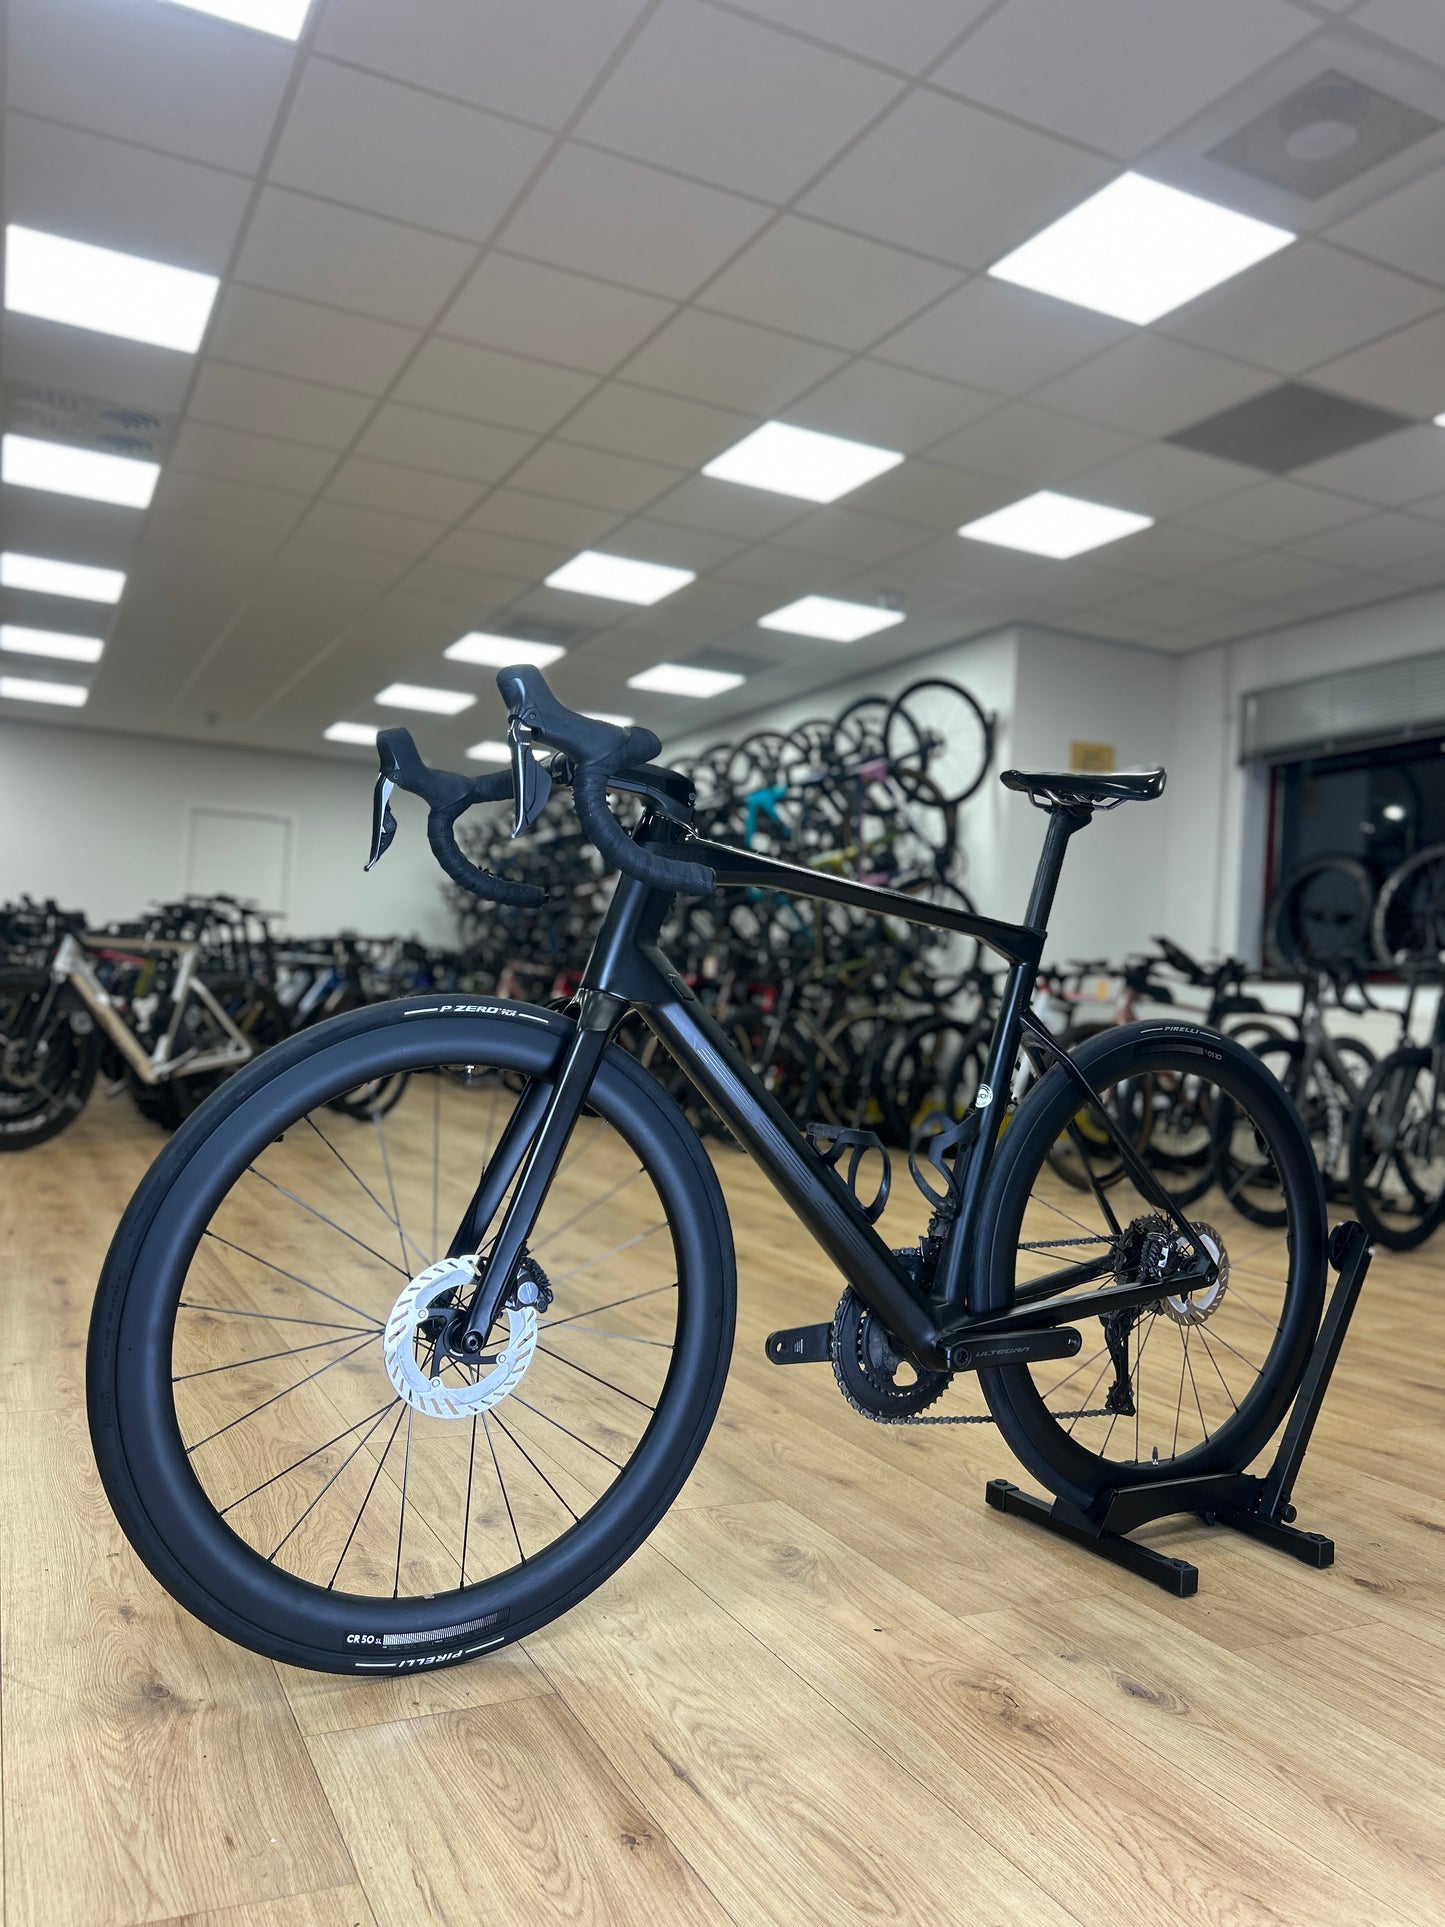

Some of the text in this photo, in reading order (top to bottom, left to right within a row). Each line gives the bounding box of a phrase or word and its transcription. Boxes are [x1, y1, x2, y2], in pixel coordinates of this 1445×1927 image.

[453, 1005, 498, 1014] ZERO
[1164, 1026, 1199, 1034] PIRELLI
[976, 1346, 1030, 1357] ULTEGRA
[398, 1650, 463, 1668] PIRELLI
